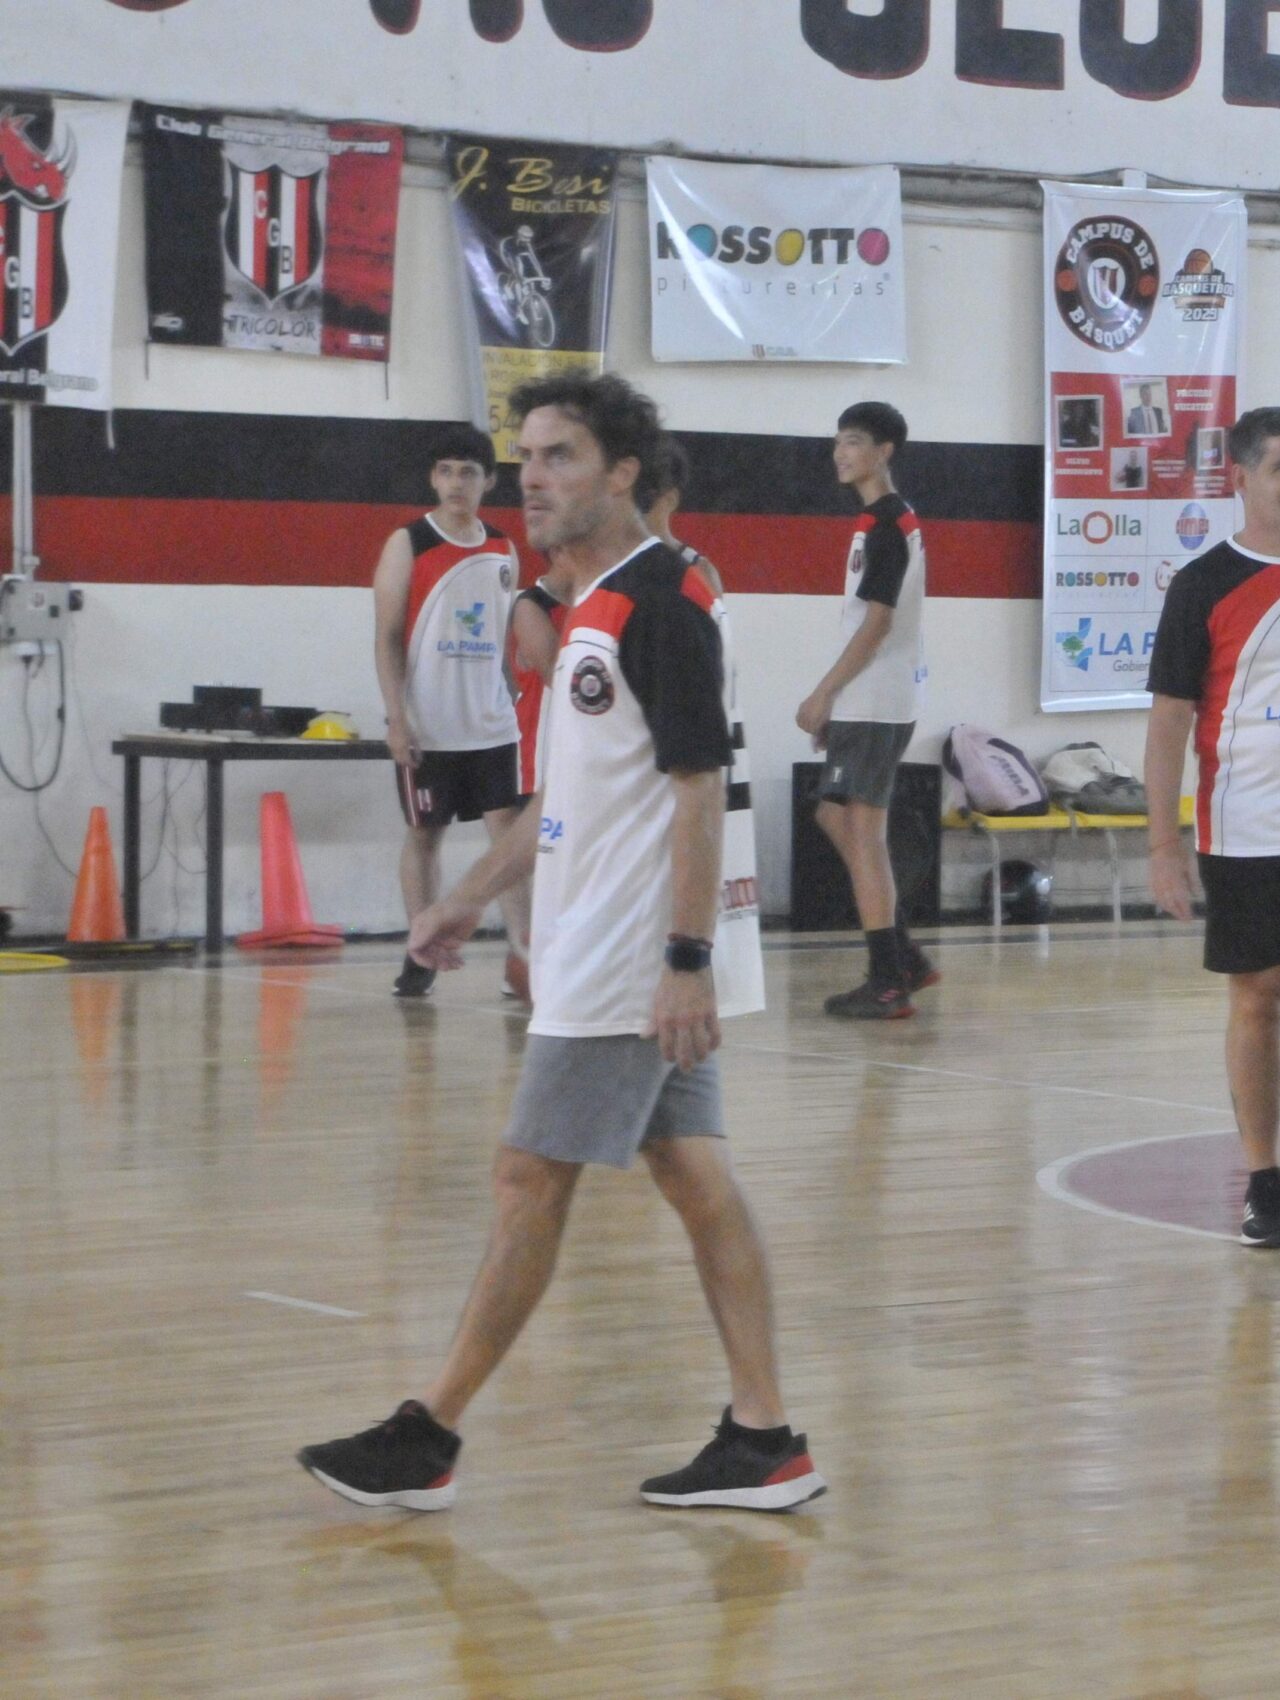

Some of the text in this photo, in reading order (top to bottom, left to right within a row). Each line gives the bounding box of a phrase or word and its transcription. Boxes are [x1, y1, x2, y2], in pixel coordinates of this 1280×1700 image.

[511, 197, 611, 215] BICICLETAS
[1066, 222, 1155, 269] CAMPUS DE
[1056, 510, 1142, 544] LaOlla
[1056, 571, 1139, 587] ROSSOTTO
[1099, 632, 1133, 656] LA
